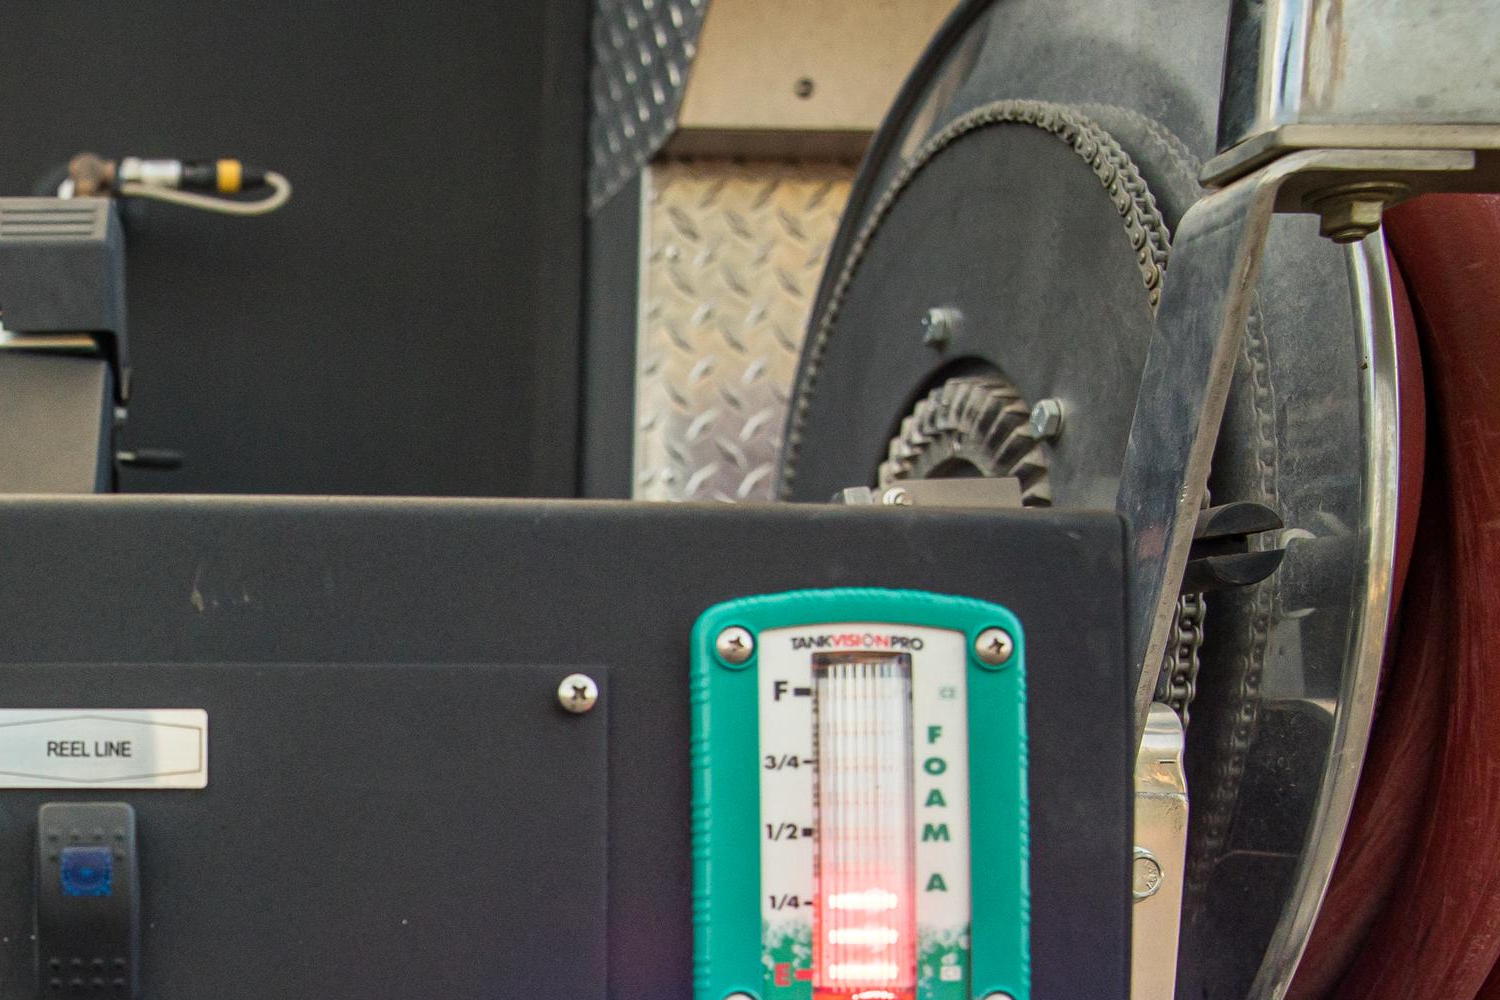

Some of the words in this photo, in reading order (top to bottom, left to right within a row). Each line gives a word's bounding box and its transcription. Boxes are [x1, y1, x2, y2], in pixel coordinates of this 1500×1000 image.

[774, 680, 789, 702] F
[46, 741, 91, 758] REEL
[94, 741, 133, 758] LINE
[764, 753, 800, 770] 3/4
[765, 823, 799, 841] 1/2
[925, 873, 949, 893] A
[768, 895, 800, 912] 1/4
[774, 962, 791, 987] E
